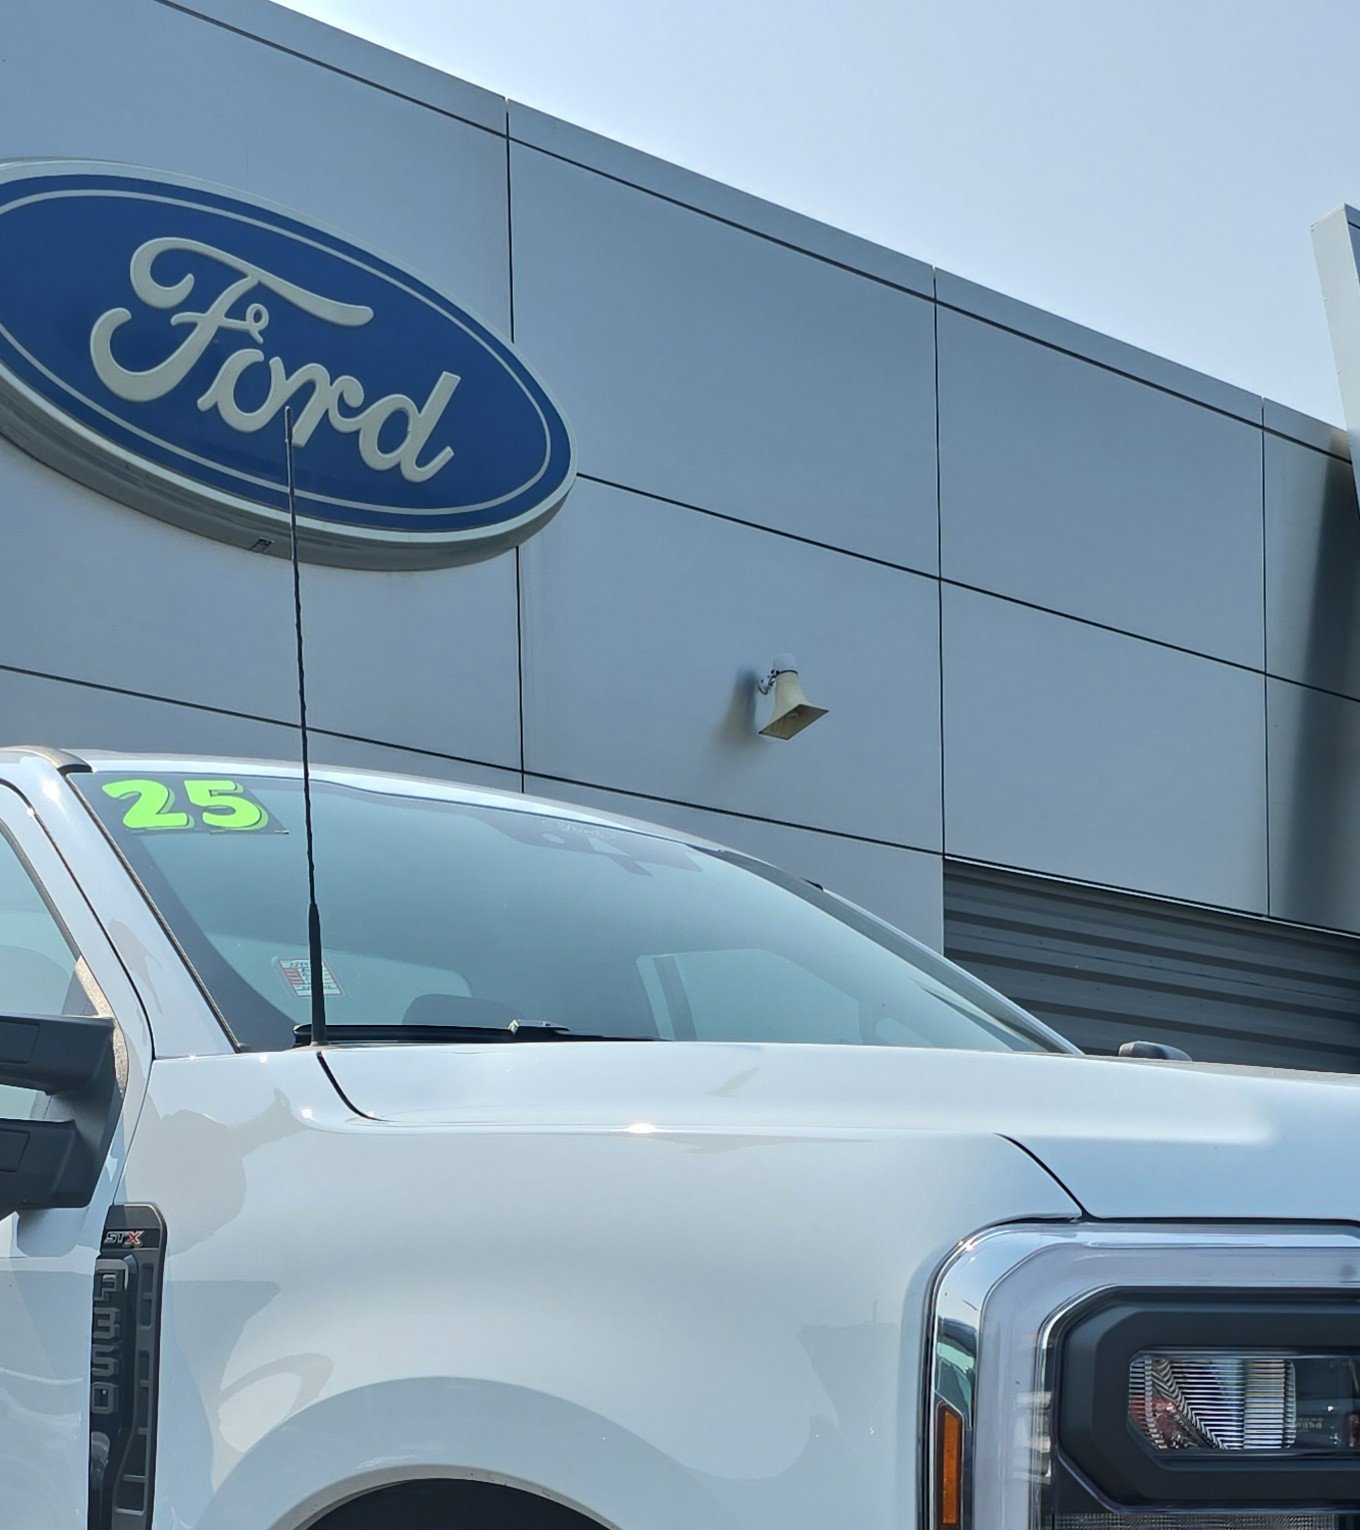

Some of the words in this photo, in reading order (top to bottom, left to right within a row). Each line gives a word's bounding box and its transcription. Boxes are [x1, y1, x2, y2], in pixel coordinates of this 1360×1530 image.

[90, 236, 462, 484] Ford
[101, 779, 270, 832] 25
[103, 1230, 145, 1249] STX
